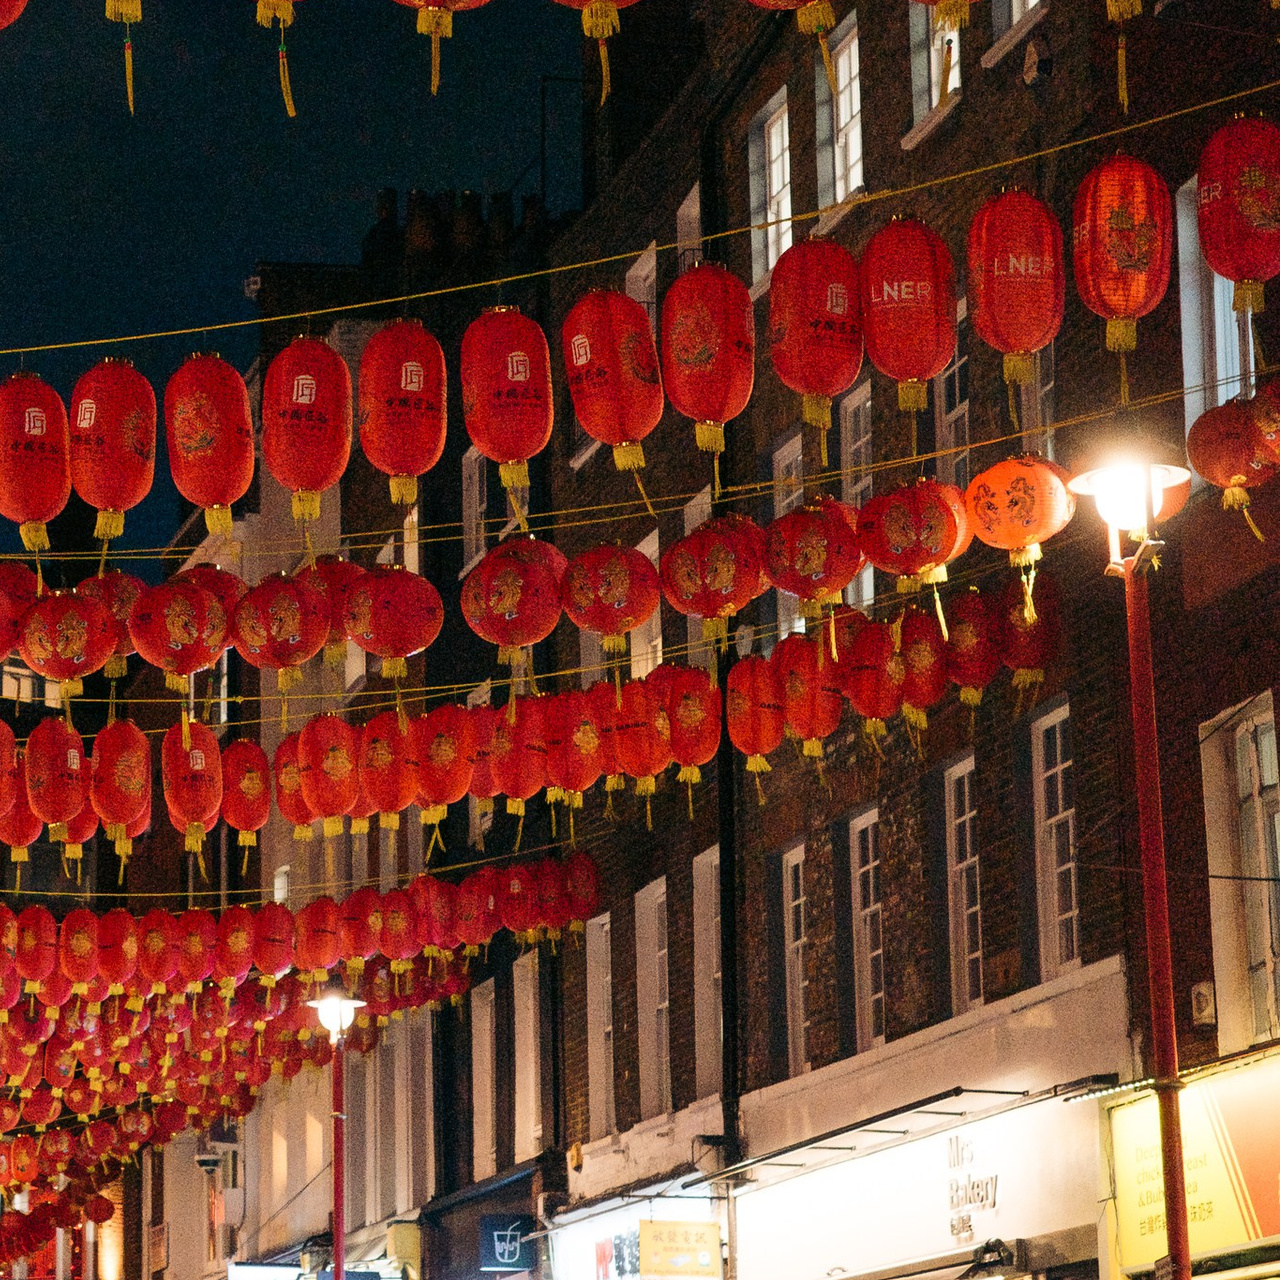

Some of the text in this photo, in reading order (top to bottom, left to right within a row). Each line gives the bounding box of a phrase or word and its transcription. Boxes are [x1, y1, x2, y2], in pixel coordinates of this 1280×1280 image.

[994, 253, 1055, 277] LNER
[871, 280, 932, 302] LNER
[949, 1174, 998, 1210] Bakery
